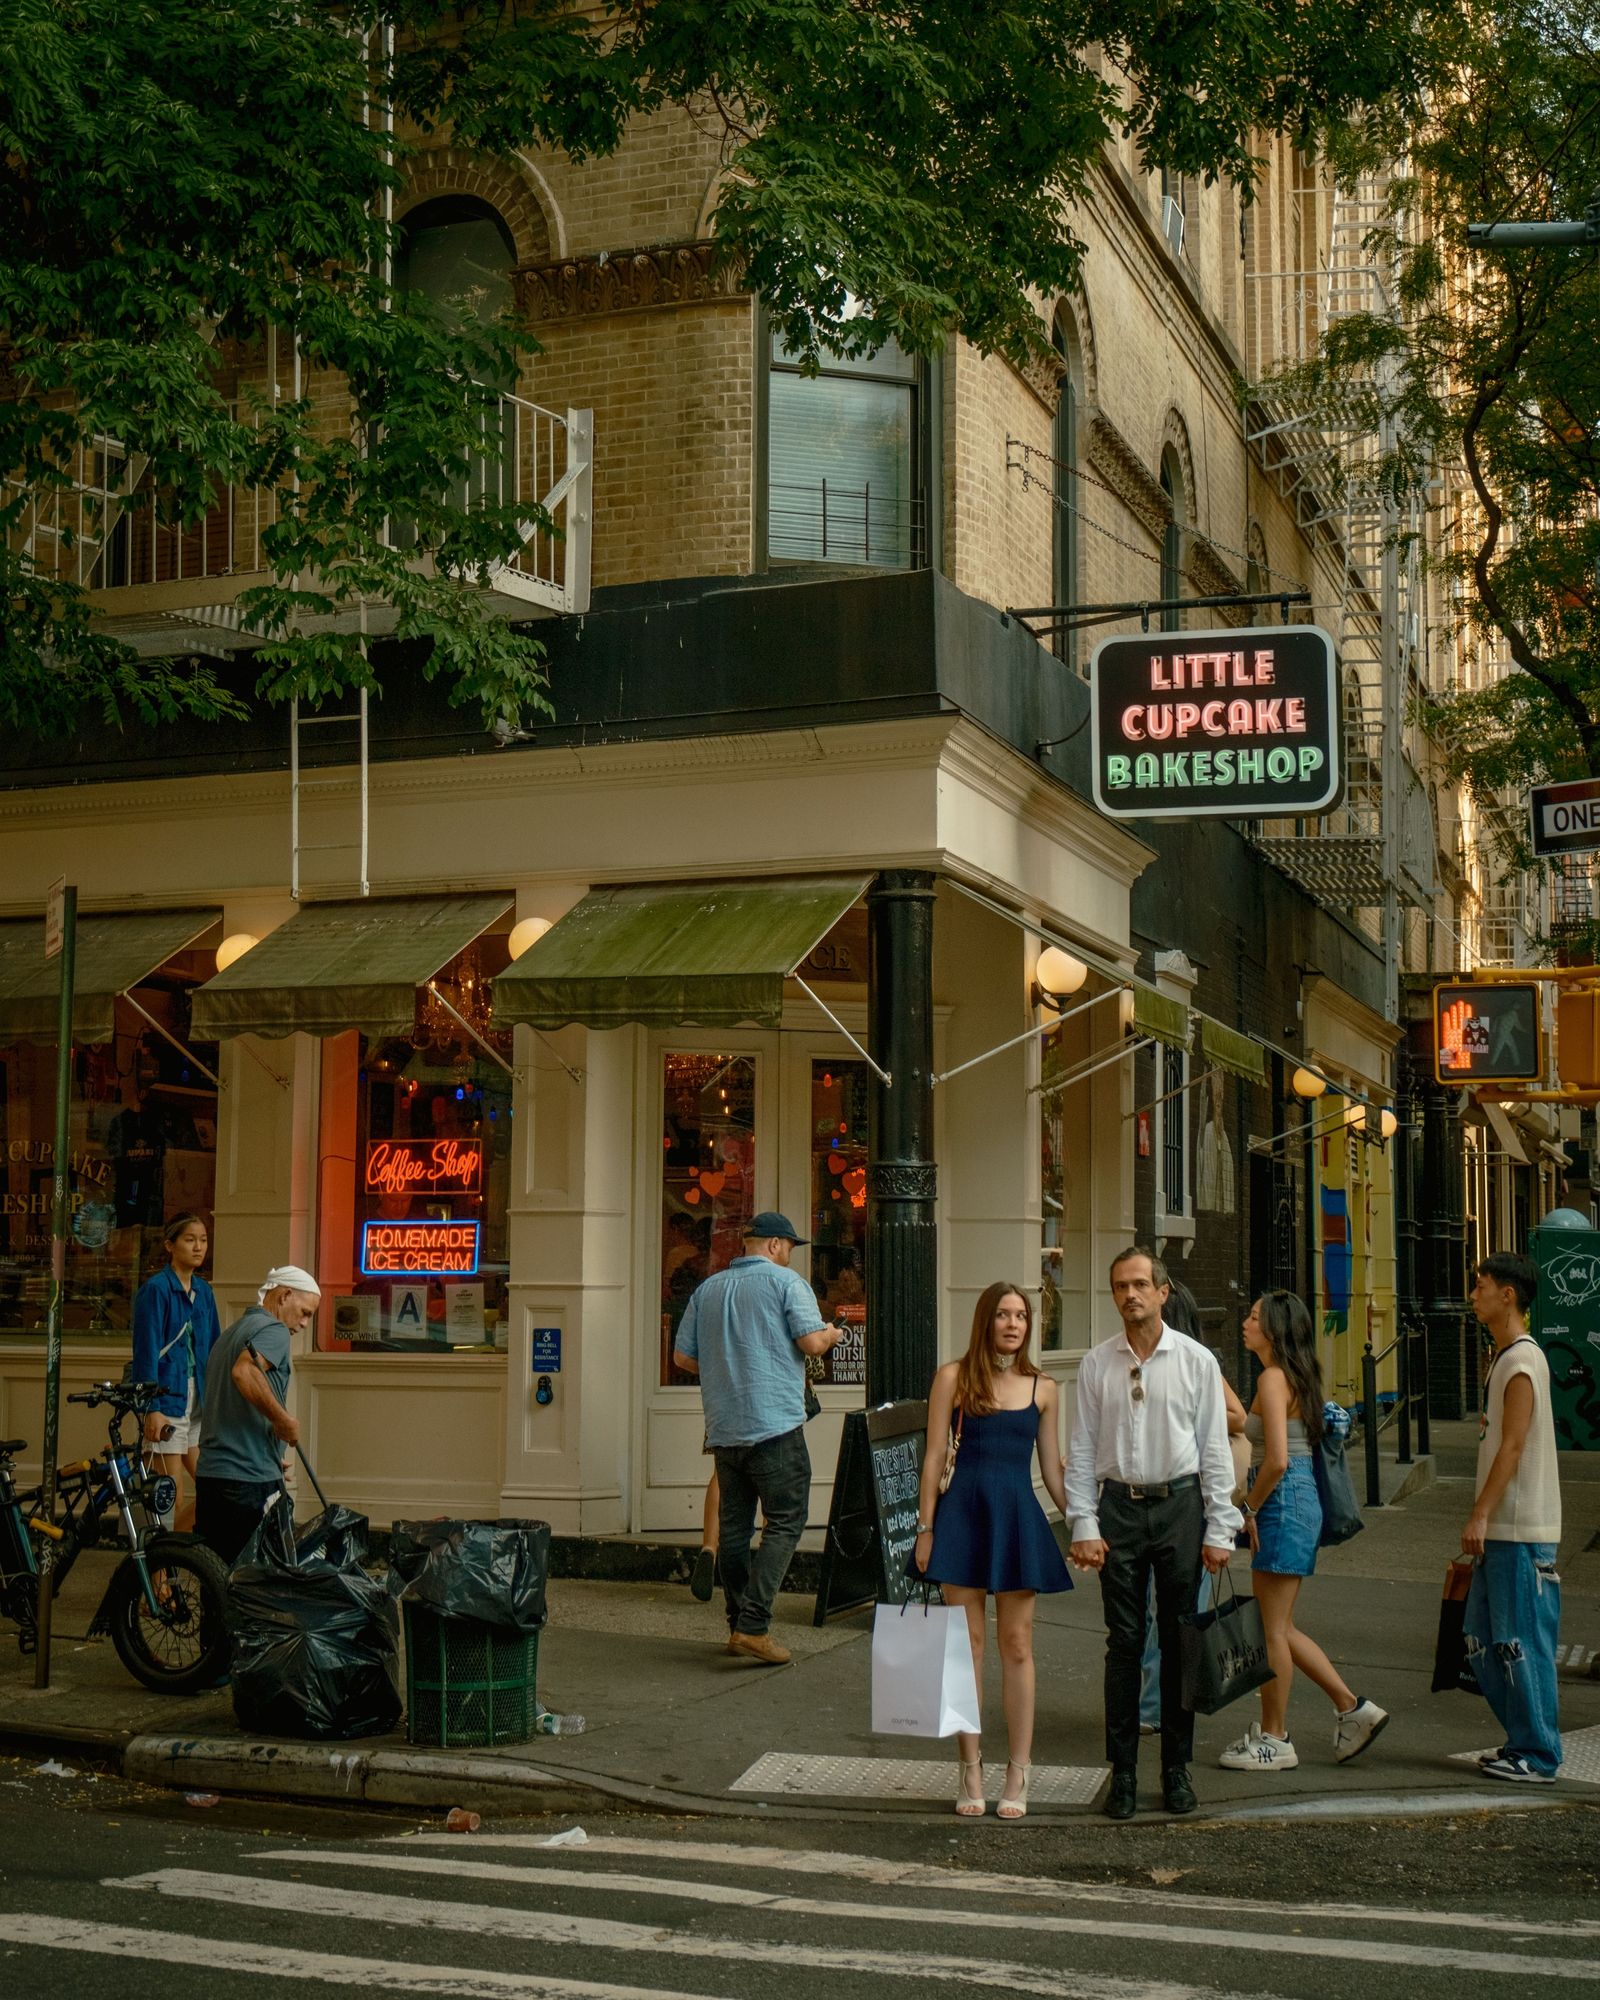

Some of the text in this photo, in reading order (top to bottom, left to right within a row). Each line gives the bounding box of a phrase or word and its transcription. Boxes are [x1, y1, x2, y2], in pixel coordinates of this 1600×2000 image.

[1151, 650, 1275, 691] LITTLE
[1121, 697, 1307, 741] CUPCAKE
[1107, 747, 1324, 790] BAKESHOP
[1553, 802, 1600, 832] ONE
[9, 1140, 112, 1187] CUPAKE
[367, 1141, 478, 1193] Coffee Shop
[2, 1192, 86, 1214] ESHP
[366, 1229, 476, 1248] HOMEMADE
[369, 1250, 472, 1272] ICE CREAM
[397, 1292, 420, 1323] A
[334, 1331, 379, 1341] FOOD WINE
[833, 1361, 847, 1369] FOOD
[848, 1361, 857, 1369] OR
[833, 1371, 858, 1382] THANK
[873, 1439, 918, 1477] FRESHLY
[879, 1471, 920, 1507] BREWED
[899, 1511, 917, 1531] Coffee
